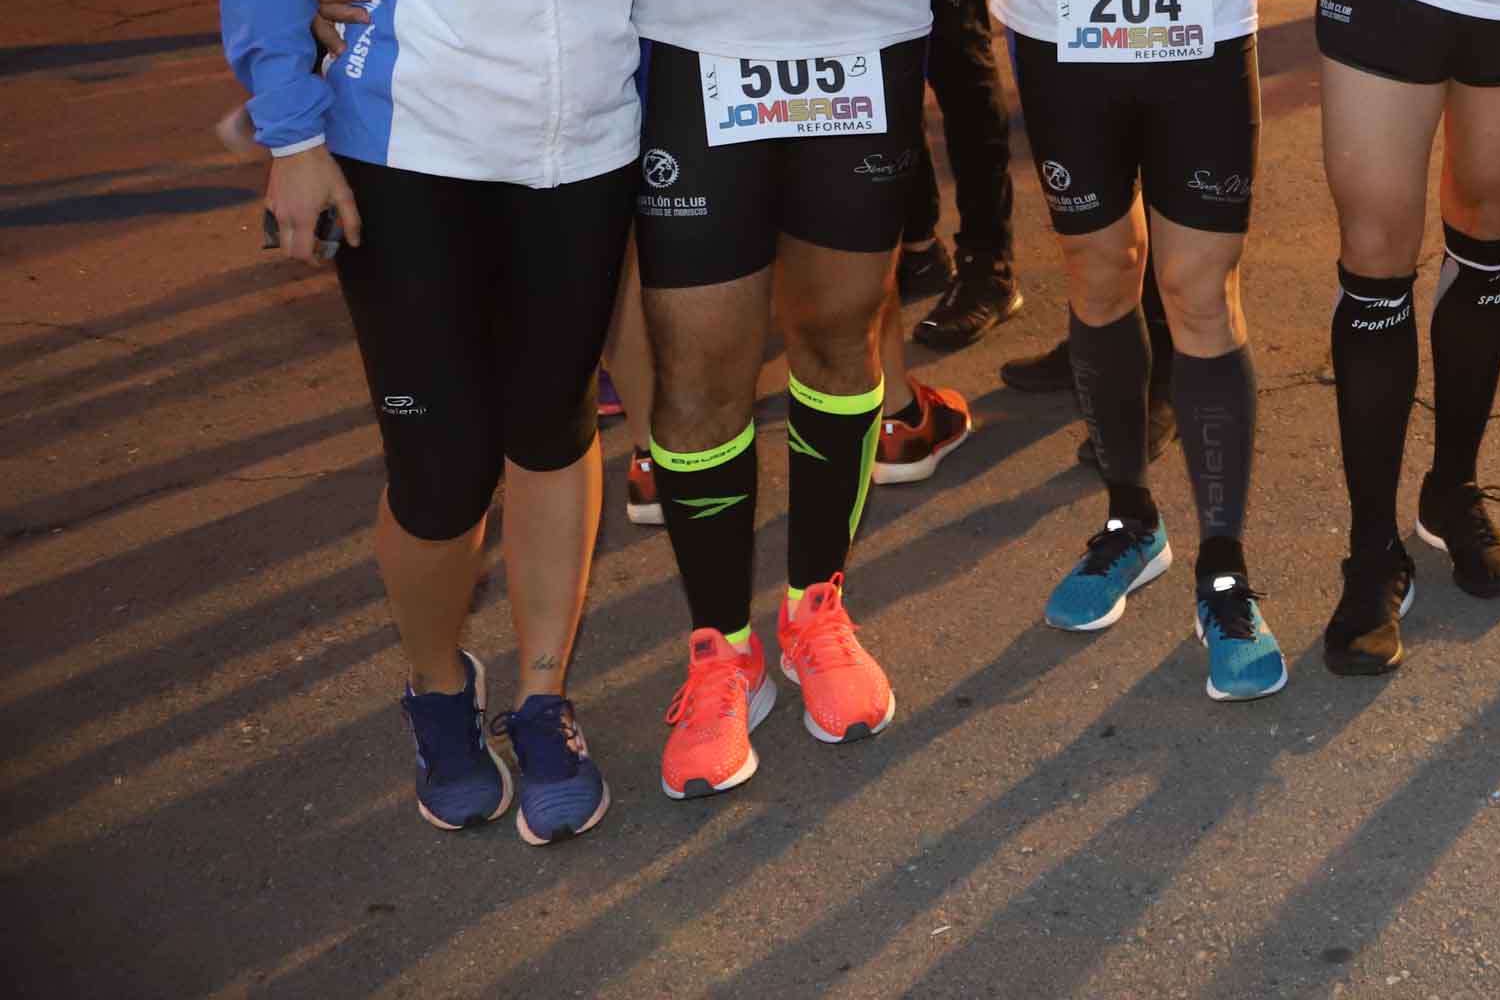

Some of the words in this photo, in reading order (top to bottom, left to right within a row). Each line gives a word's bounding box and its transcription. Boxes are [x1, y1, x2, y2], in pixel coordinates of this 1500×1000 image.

[1068, 25, 1204, 49] JOMISAGA
[1135, 47, 1203, 59] REFORMAS
[739, 57, 846, 98] 505
[719, 96, 873, 130] JOMISAGA
[797, 120, 873, 133] REFORMAS
[674, 196, 706, 208] CLUB
